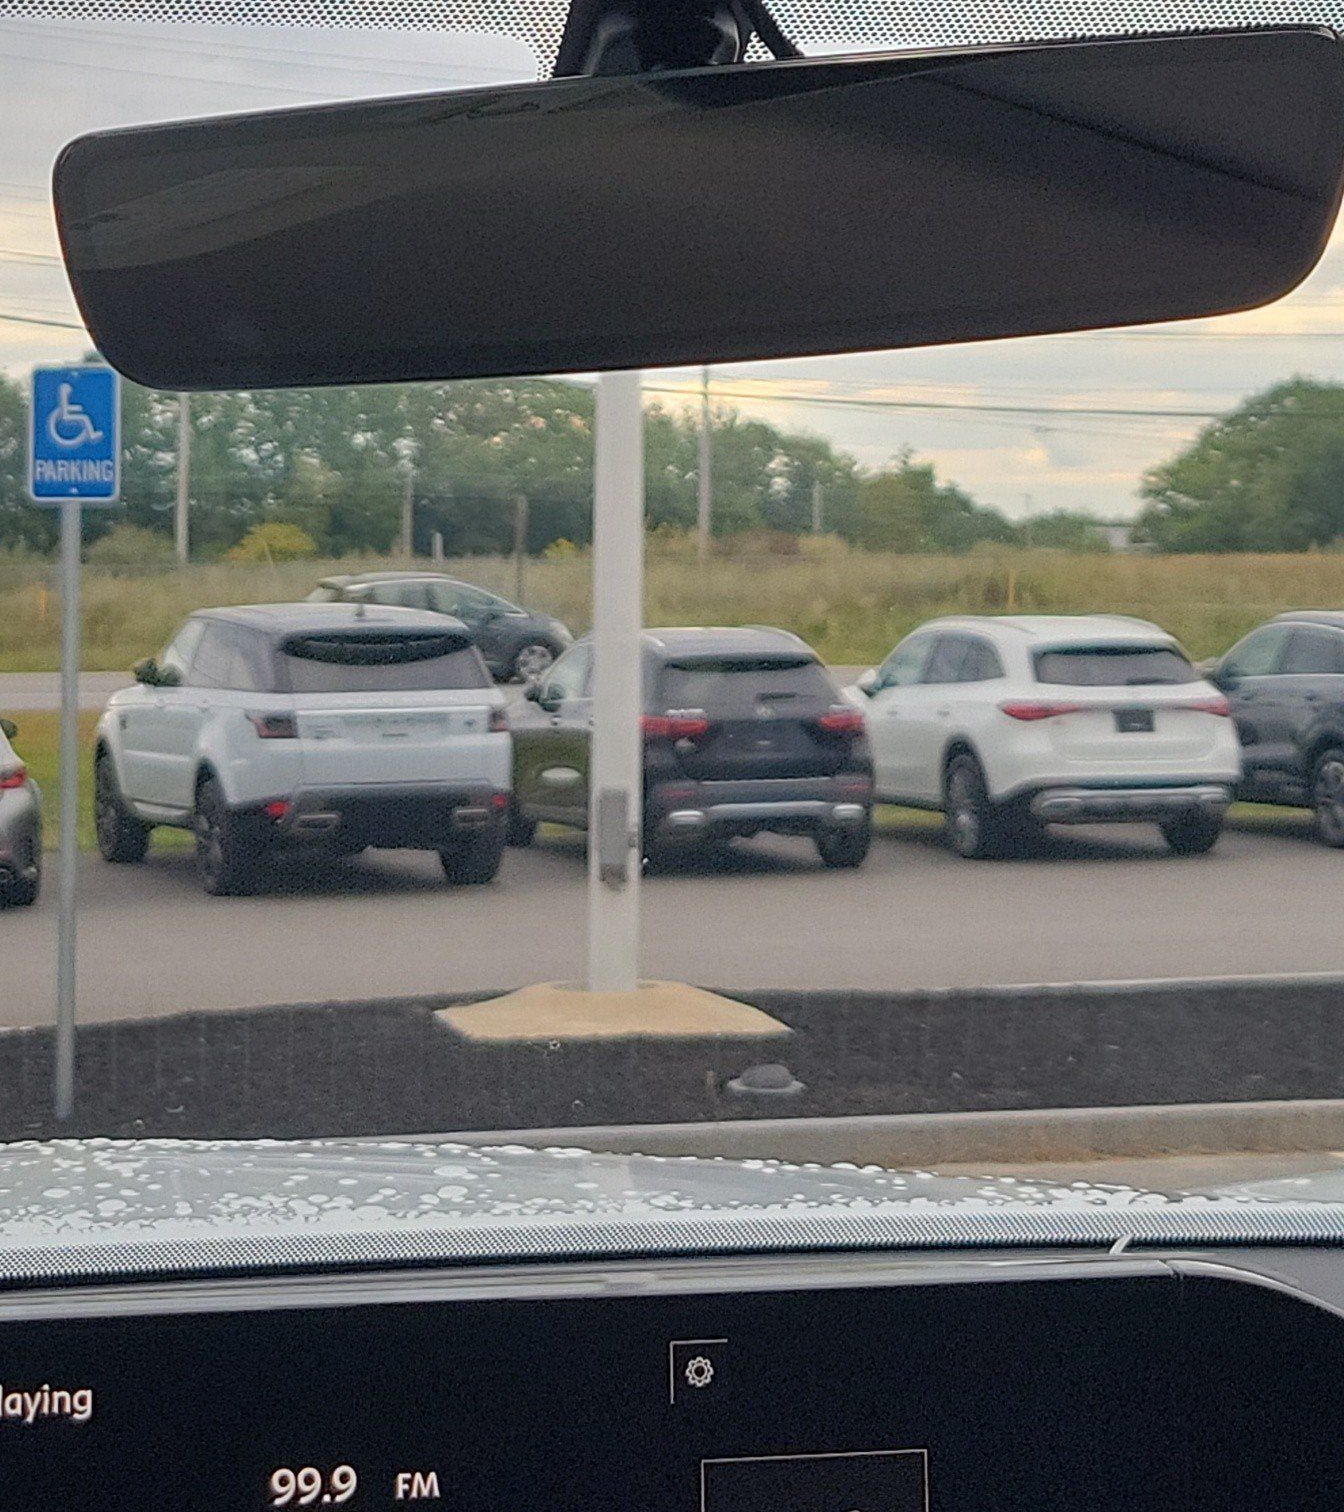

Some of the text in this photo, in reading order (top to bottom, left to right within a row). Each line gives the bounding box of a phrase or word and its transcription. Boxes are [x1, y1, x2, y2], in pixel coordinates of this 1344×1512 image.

[35, 459, 114, 482] PARKING
[270, 1464, 441, 1506] 99.9 FM
